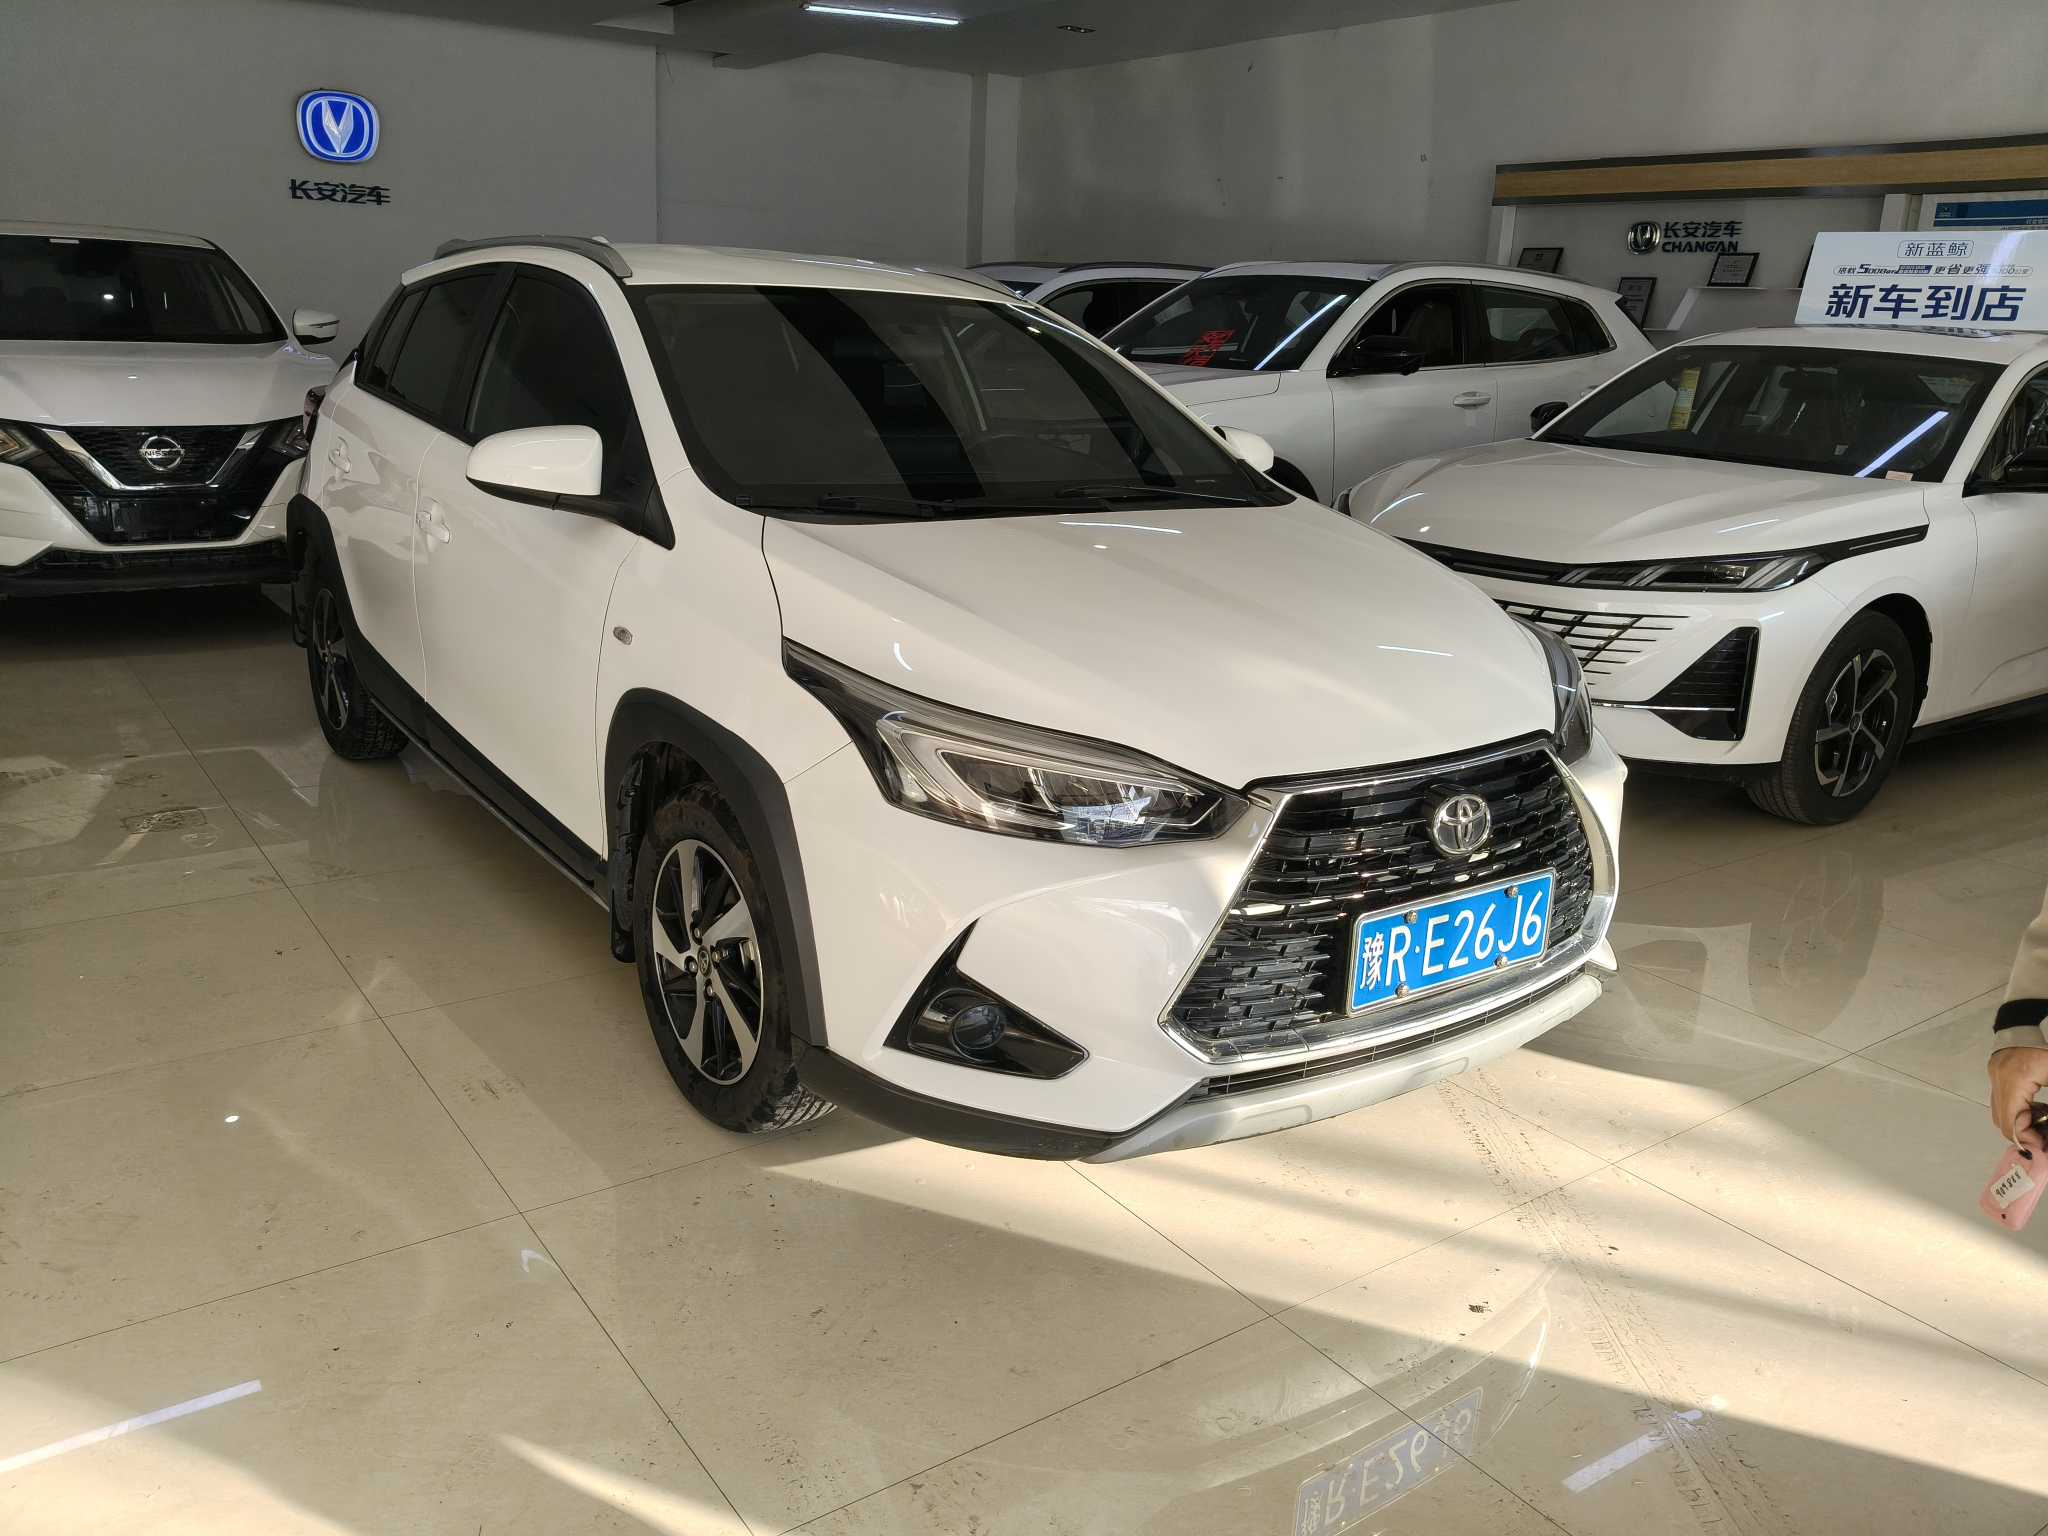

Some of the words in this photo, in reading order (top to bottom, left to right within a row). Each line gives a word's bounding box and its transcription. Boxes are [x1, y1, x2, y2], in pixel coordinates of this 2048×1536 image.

[289, 179, 391, 206] 长安汽车
[1663, 220, 1743, 239] 长安汽车
[1662, 241, 1738, 253] CHANGAN
[1904, 241, 1969, 257] 新蓝鲸
[1825, 283, 2027, 322] 新车到店
